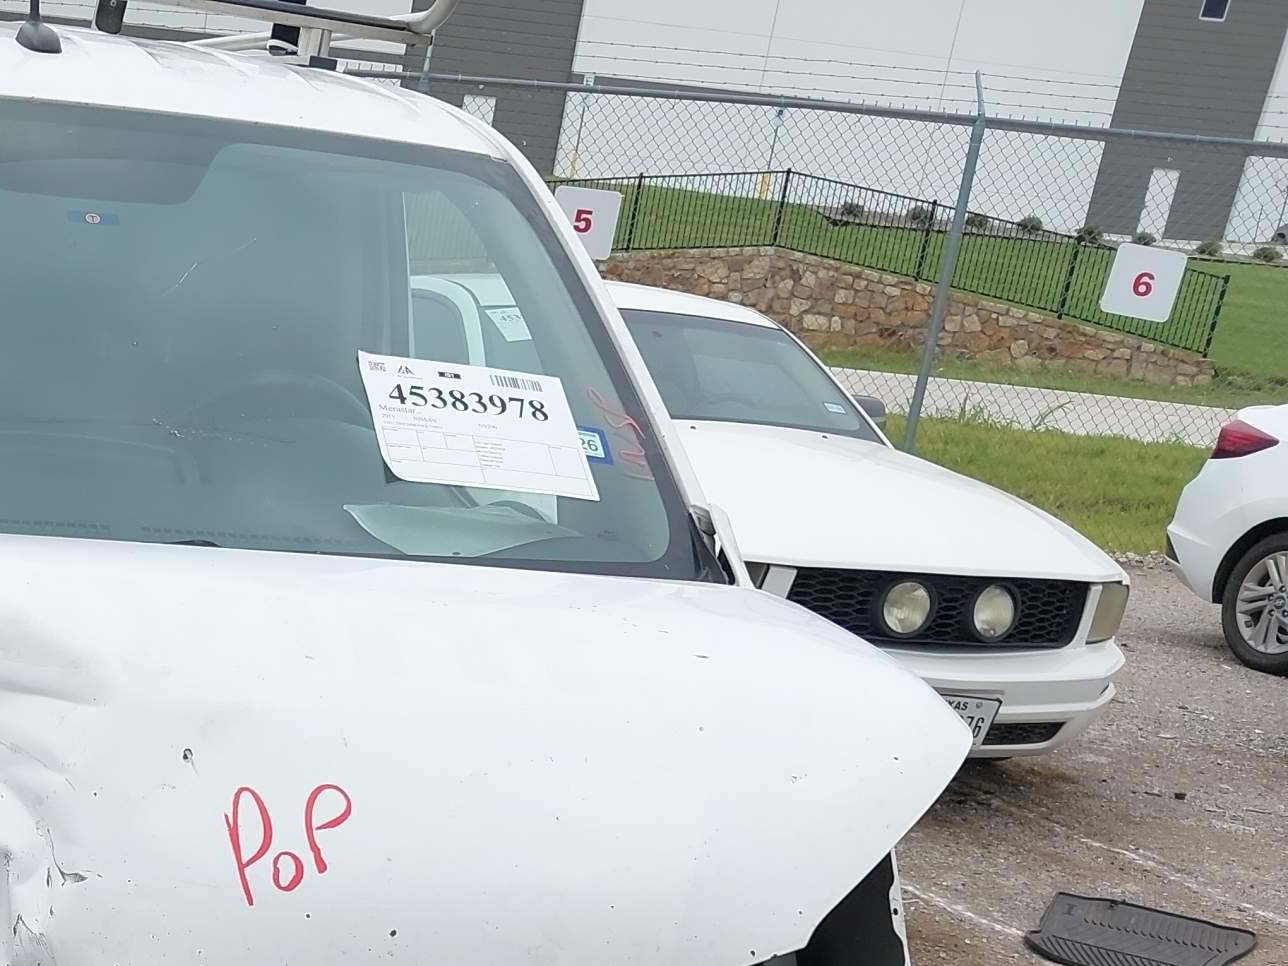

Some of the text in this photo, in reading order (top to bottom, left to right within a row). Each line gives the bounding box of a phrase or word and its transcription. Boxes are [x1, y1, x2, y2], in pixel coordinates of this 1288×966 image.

[573, 209, 593, 233] 5
[1133, 272, 1155, 297] 6
[389, 384, 549, 422] 45383978
[960, 715, 985, 739] 76
